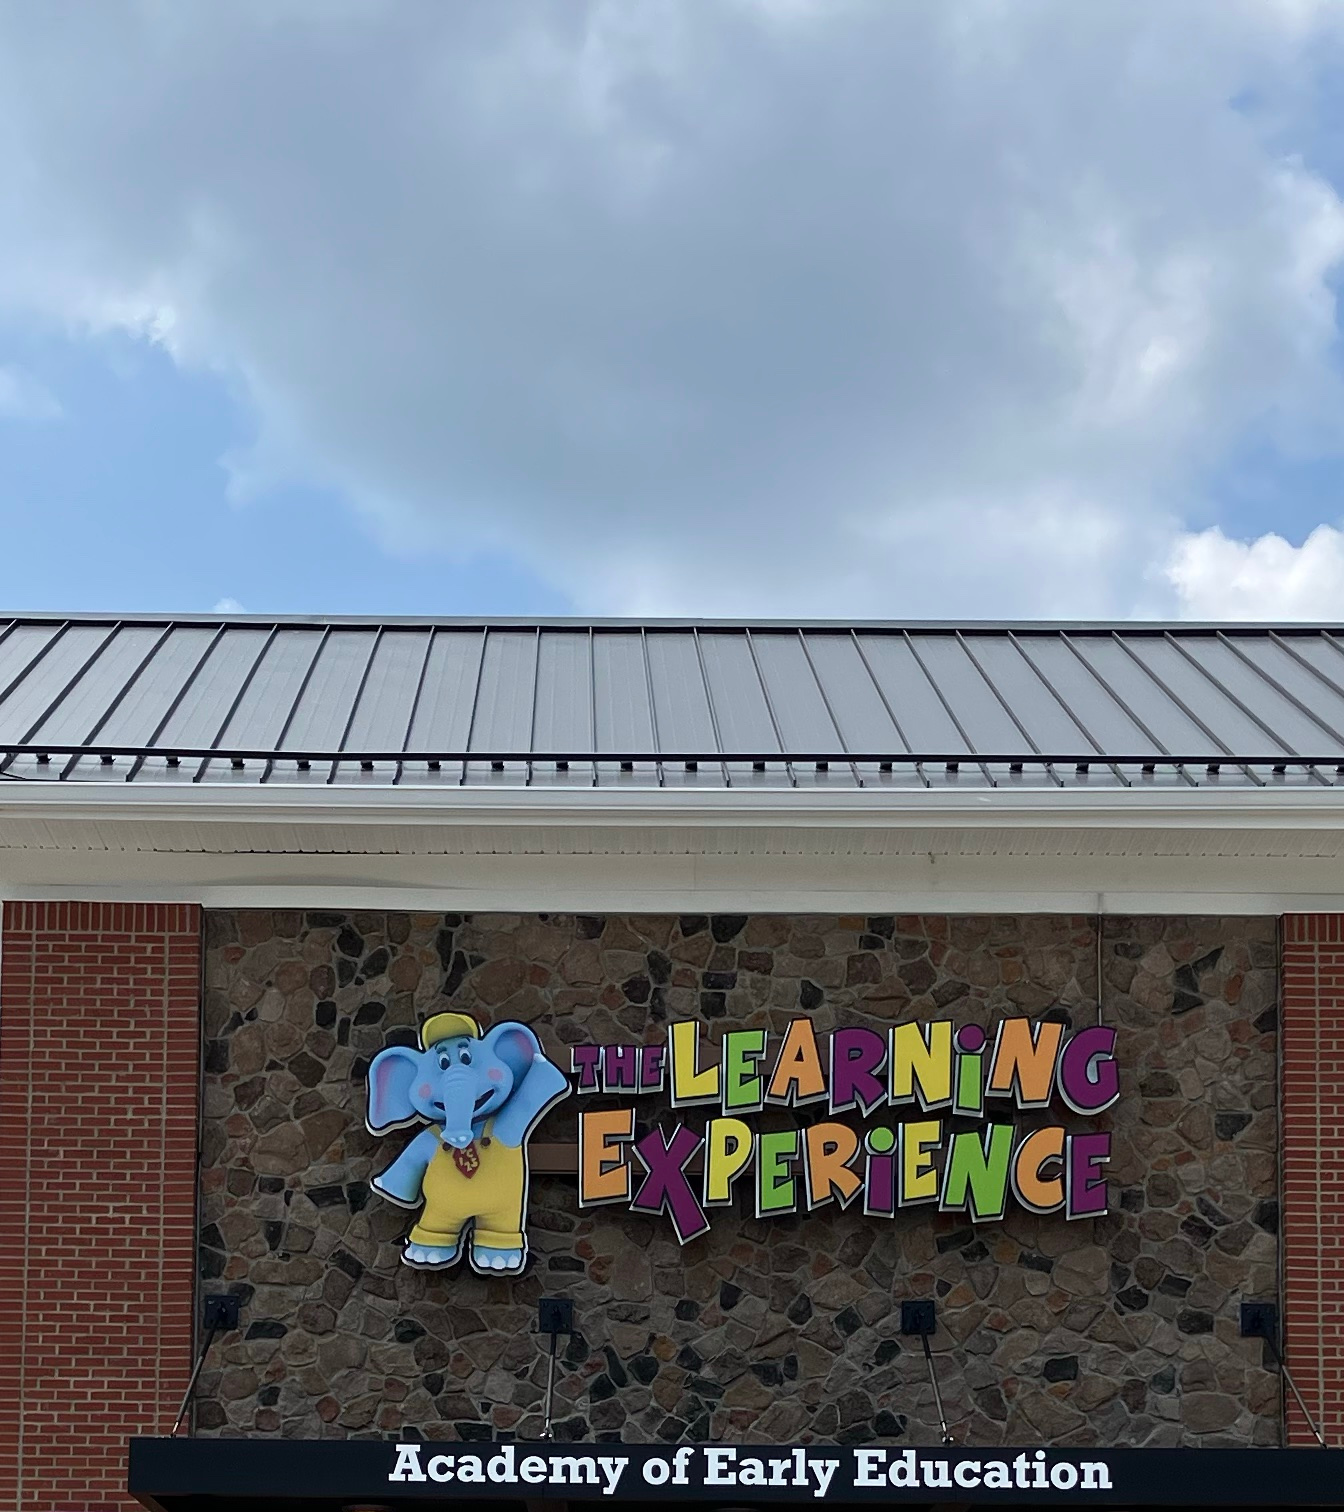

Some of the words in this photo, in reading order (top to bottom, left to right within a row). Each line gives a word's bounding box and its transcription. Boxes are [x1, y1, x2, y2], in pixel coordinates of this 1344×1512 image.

[570, 1044, 666, 1094] THE
[388, 1444, 629, 1495] Academy
[642, 1446, 695, 1485] of
[703, 1448, 840, 1498] Early
[853, 1449, 1113, 1490] Education
